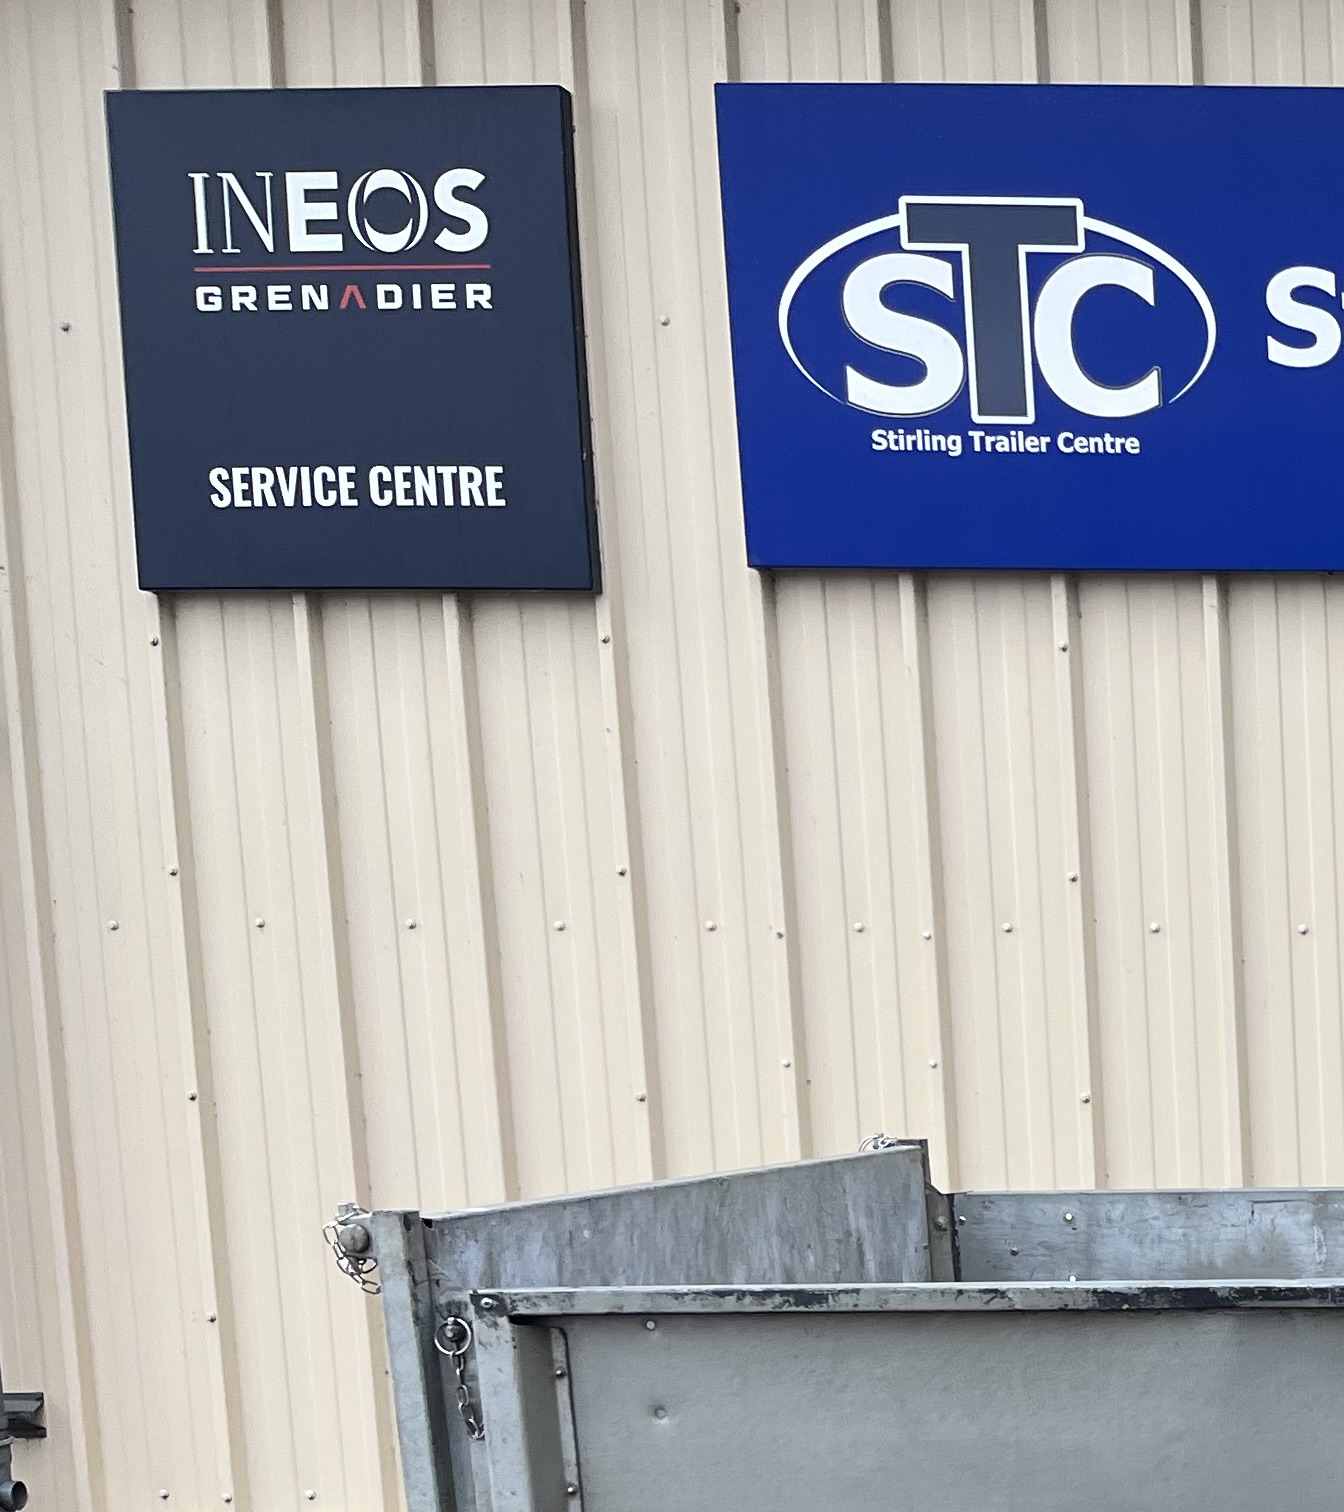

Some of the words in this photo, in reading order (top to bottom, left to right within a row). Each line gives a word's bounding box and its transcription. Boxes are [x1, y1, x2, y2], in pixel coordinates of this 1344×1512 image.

[188, 168, 489, 254] INEOS
[195, 283, 493, 312] GRENADIER
[842, 195, 1163, 425] STC
[871, 428, 963, 457] Stirling
[967, 430, 1051, 453] Trailer
[1056, 431, 1141, 454] Centre
[208, 465, 359, 508] SERVICE
[368, 465, 506, 507] CENTRE
